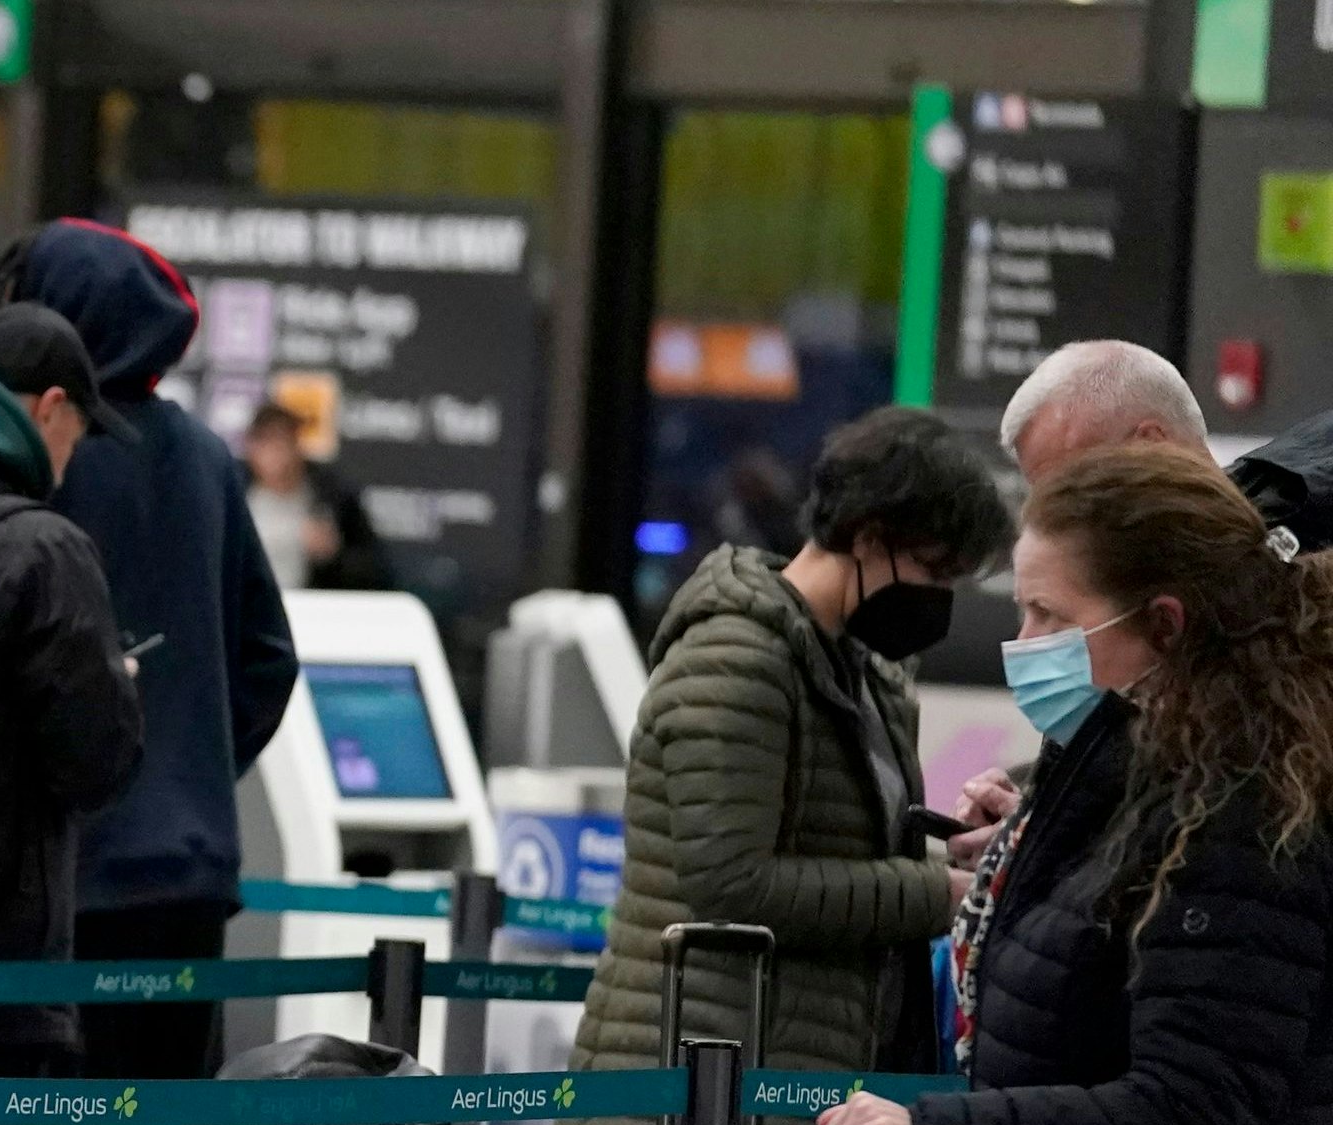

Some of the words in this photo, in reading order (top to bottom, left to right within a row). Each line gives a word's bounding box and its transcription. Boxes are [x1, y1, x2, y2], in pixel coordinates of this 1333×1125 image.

[93, 972, 122, 992] Aer
[122, 973, 172, 999] Lingus
[4, 1092, 42, 1115] Aer
[43, 1092, 107, 1122] Lingus
[451, 1088, 485, 1109] Aer
[486, 1085, 547, 1115] Lingus
[754, 1081, 786, 1103] Aer
[786, 1082, 841, 1112] Lingus
